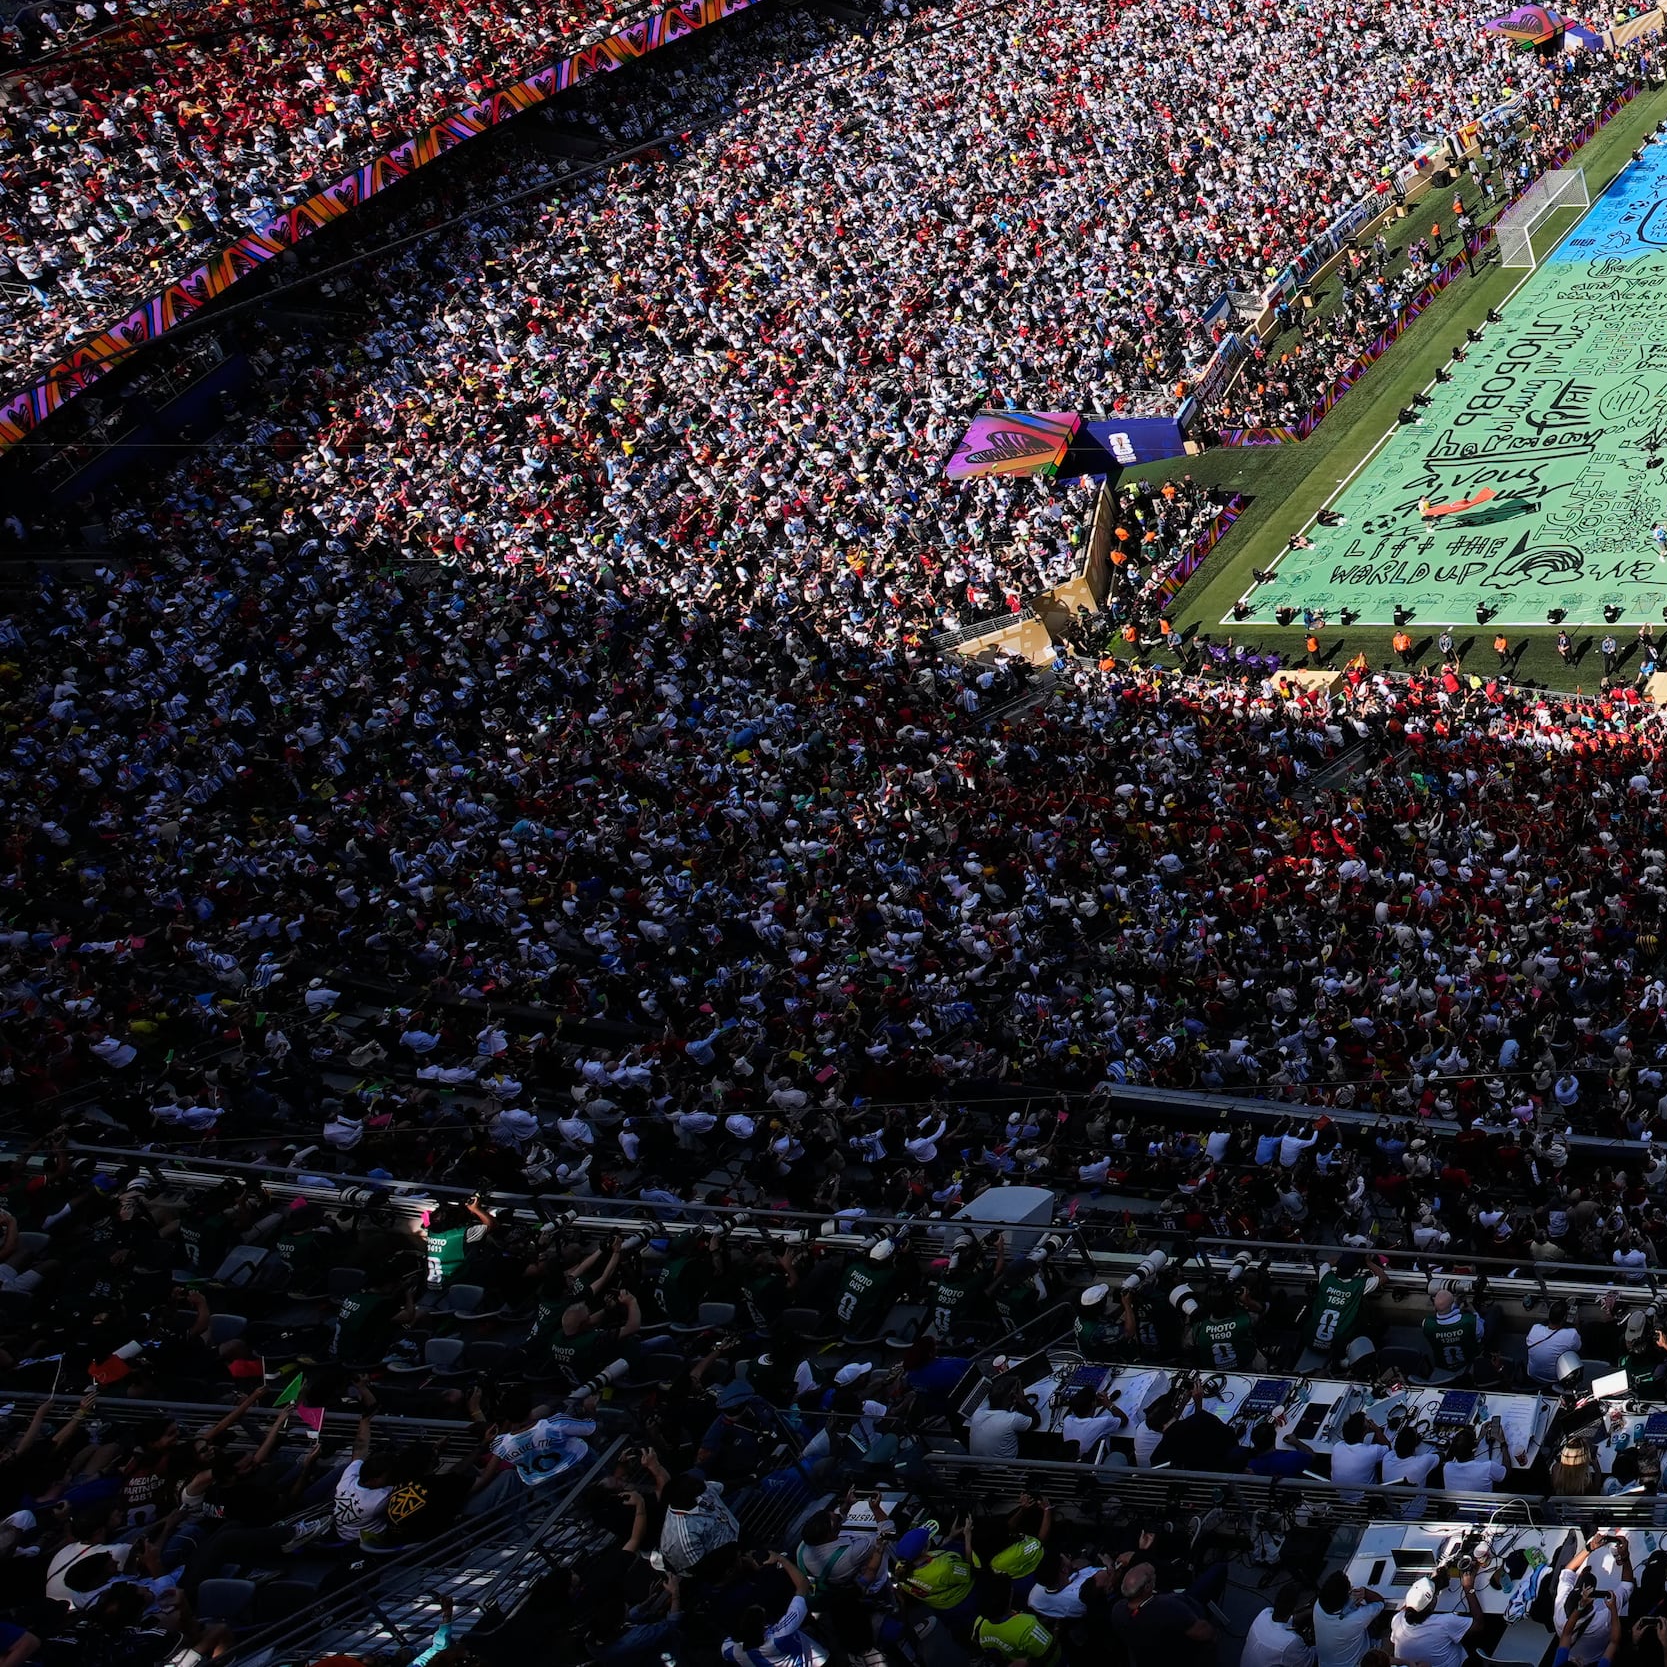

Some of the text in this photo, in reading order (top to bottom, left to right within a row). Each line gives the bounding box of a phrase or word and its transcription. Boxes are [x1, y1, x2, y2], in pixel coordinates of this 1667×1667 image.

[1330, 560, 1432, 585] WORLD
[853, 1270, 874, 1286] PHOTO
[939, 1285, 967, 1298] PHOTO
[1328, 1286, 1354, 1298] PHOTO
[1206, 1322, 1239, 1334] PHOTO
[553, 1344, 579, 1355] PHOTO
